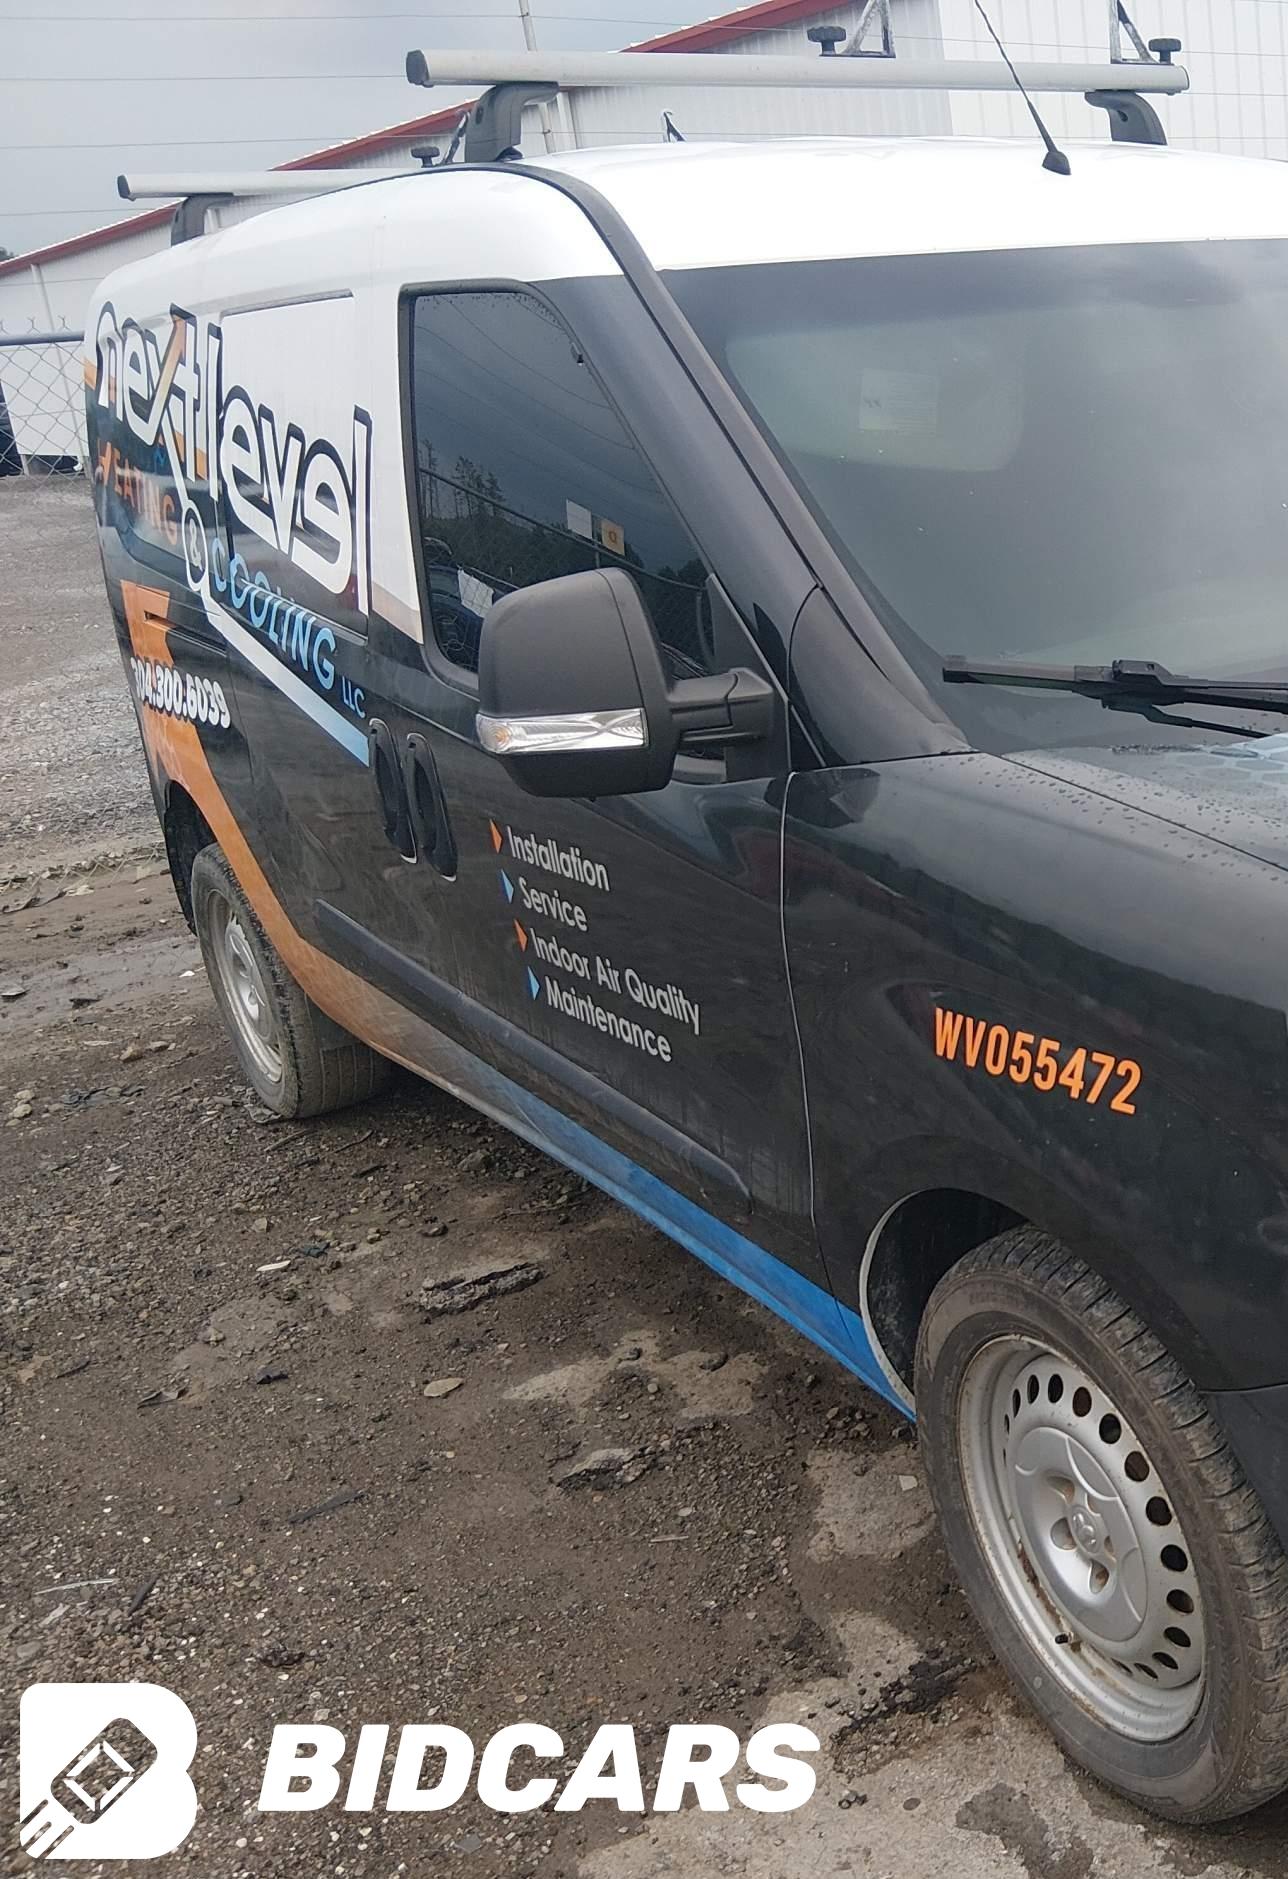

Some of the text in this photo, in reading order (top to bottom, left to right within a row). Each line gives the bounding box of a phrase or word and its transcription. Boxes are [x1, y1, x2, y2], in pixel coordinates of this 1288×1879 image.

[212, 537, 337, 691] COOLING
[341, 675, 367, 719] LLC
[506, 825, 611, 892] Installation
[518, 876, 588, 932] Service
[529, 927, 700, 1036] Indoor Air Quality
[544, 975, 672, 1062] Maintenance
[934, 1006, 1142, 1115] WV055472
